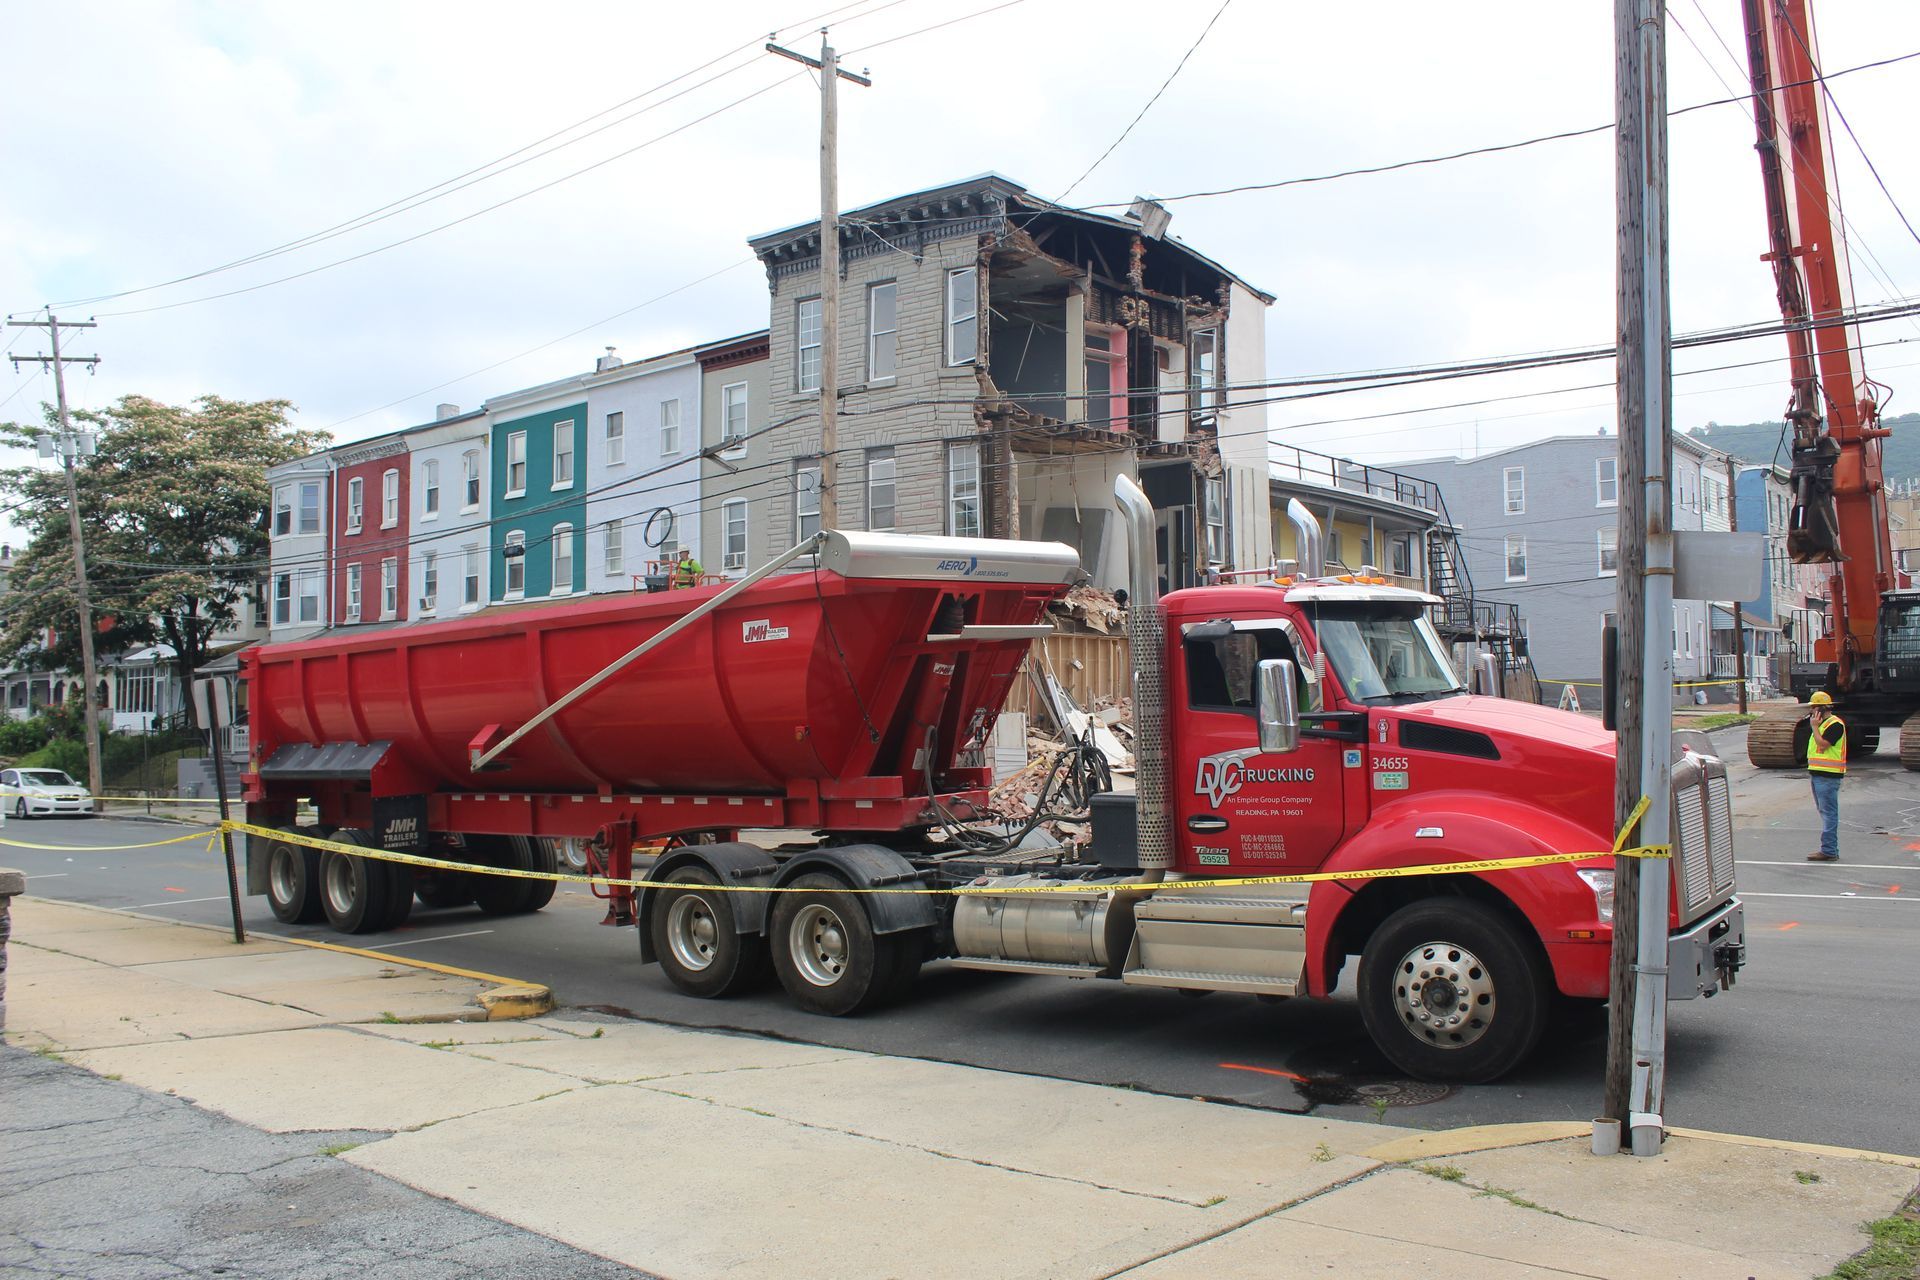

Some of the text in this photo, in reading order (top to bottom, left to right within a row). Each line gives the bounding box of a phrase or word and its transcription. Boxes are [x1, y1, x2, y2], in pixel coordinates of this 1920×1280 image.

[937, 560, 967, 571] AERO
[745, 625, 768, 642] JMH
[1372, 758, 1409, 770] 34655
[1238, 768, 1315, 782] TRUCKING
[1237, 796, 1259, 804] Empire
[1260, 796, 1280, 804] Group
[1281, 795, 1313, 804] Company
[1235, 809, 1269, 817] READING,
[385, 818, 417, 834] JMH
[266, 830, 285, 840] CAUTION
[320, 841, 341, 850] CAUTION
[383, 832, 418, 842] TRAILERS
[1202, 855, 1228, 864] 29523
